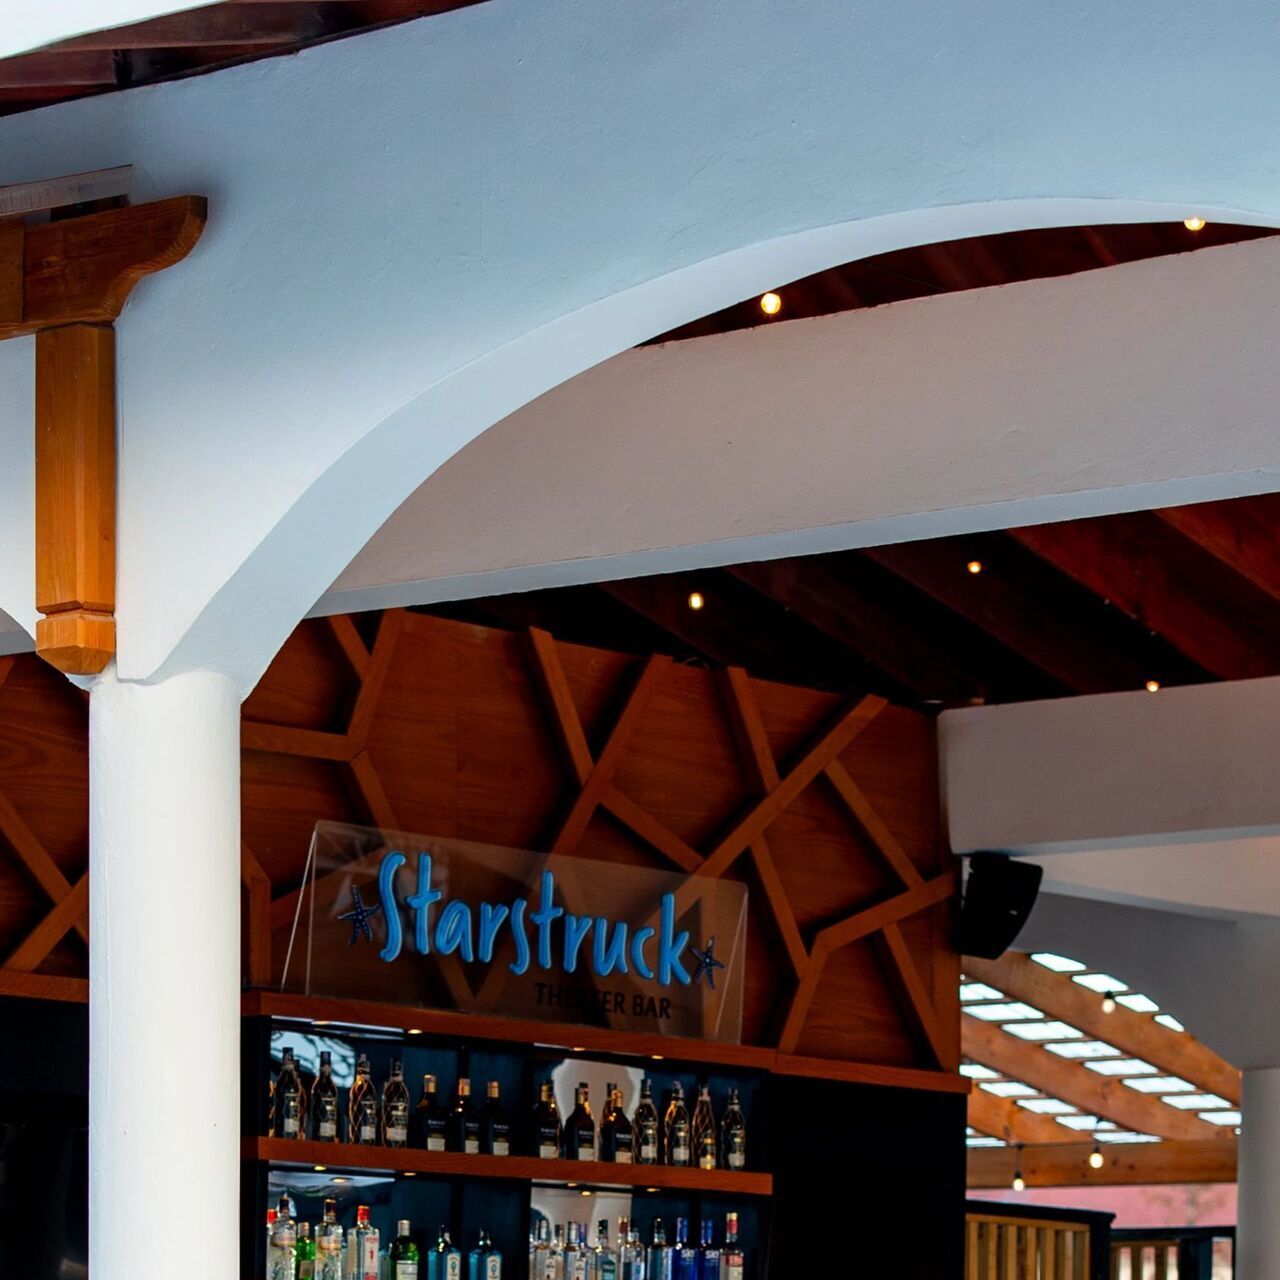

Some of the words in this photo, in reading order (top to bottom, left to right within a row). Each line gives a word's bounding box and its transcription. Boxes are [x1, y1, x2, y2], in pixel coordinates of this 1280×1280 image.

[378, 851, 691, 986] Starstruck
[534, 982, 625, 1015] THER
[632, 993, 672, 1020] BAR
